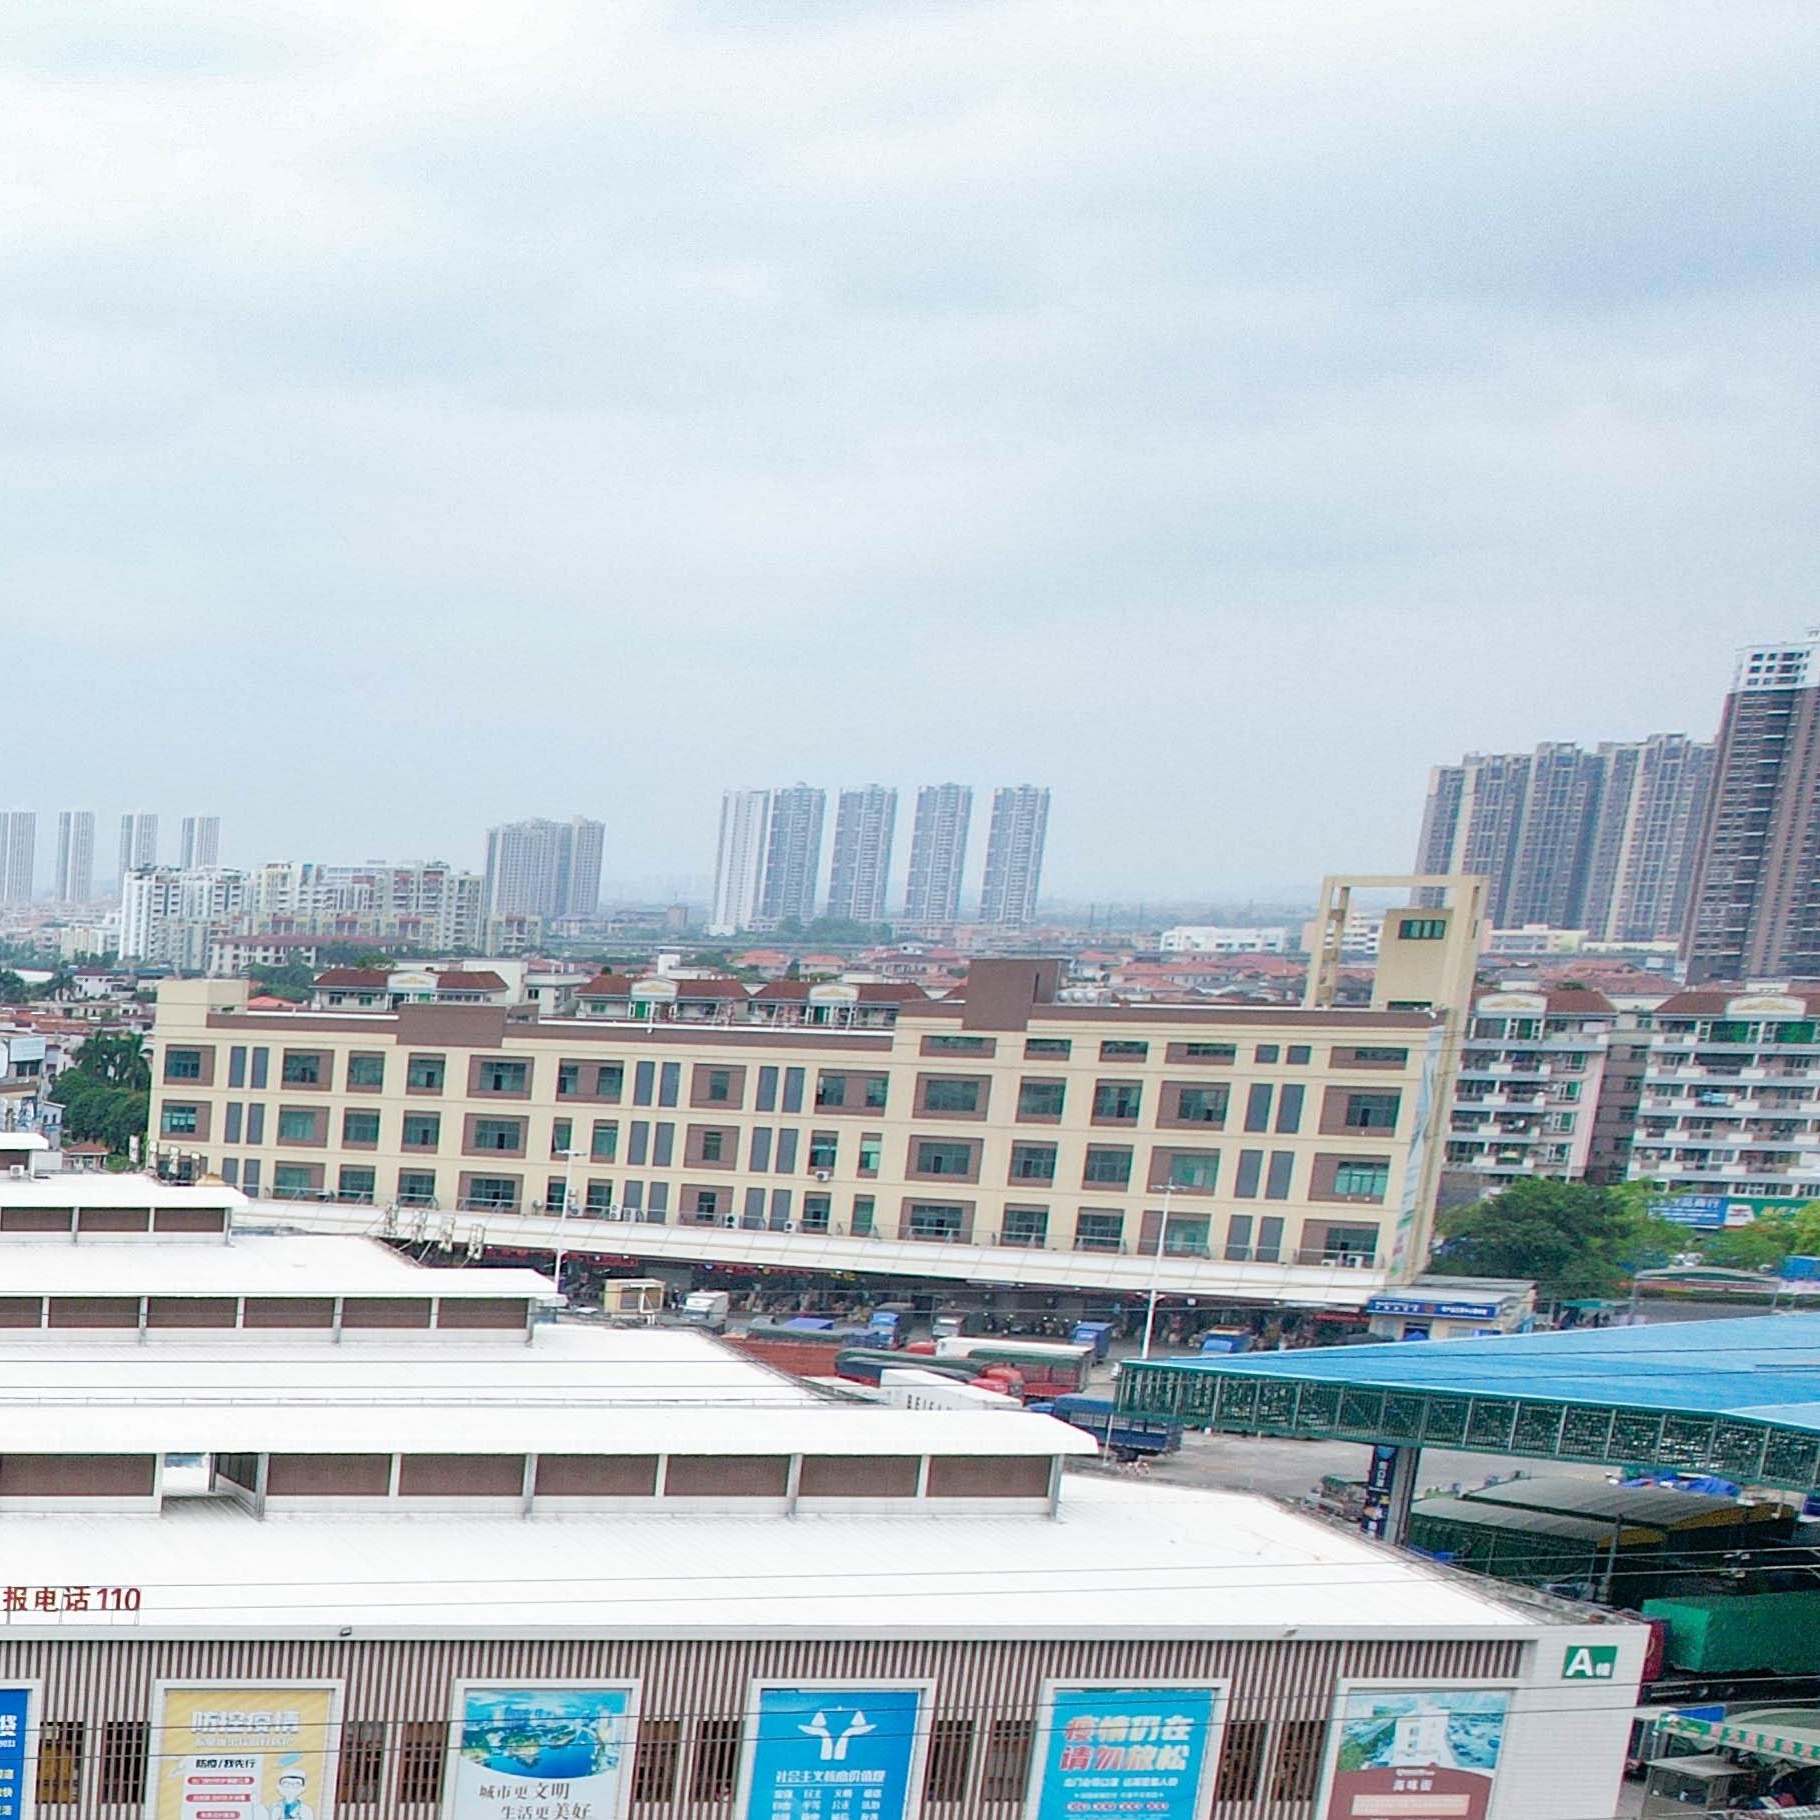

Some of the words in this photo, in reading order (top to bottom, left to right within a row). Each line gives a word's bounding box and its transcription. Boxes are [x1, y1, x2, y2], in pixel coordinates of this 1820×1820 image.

[1064, 1714, 1195, 1742] 疫情仍在
[1059, 1745, 1191, 1771] 请勿放松
[479, 1782, 570, 1800] 城市更文明
[501, 1802, 591, 1820] 生活更美好
